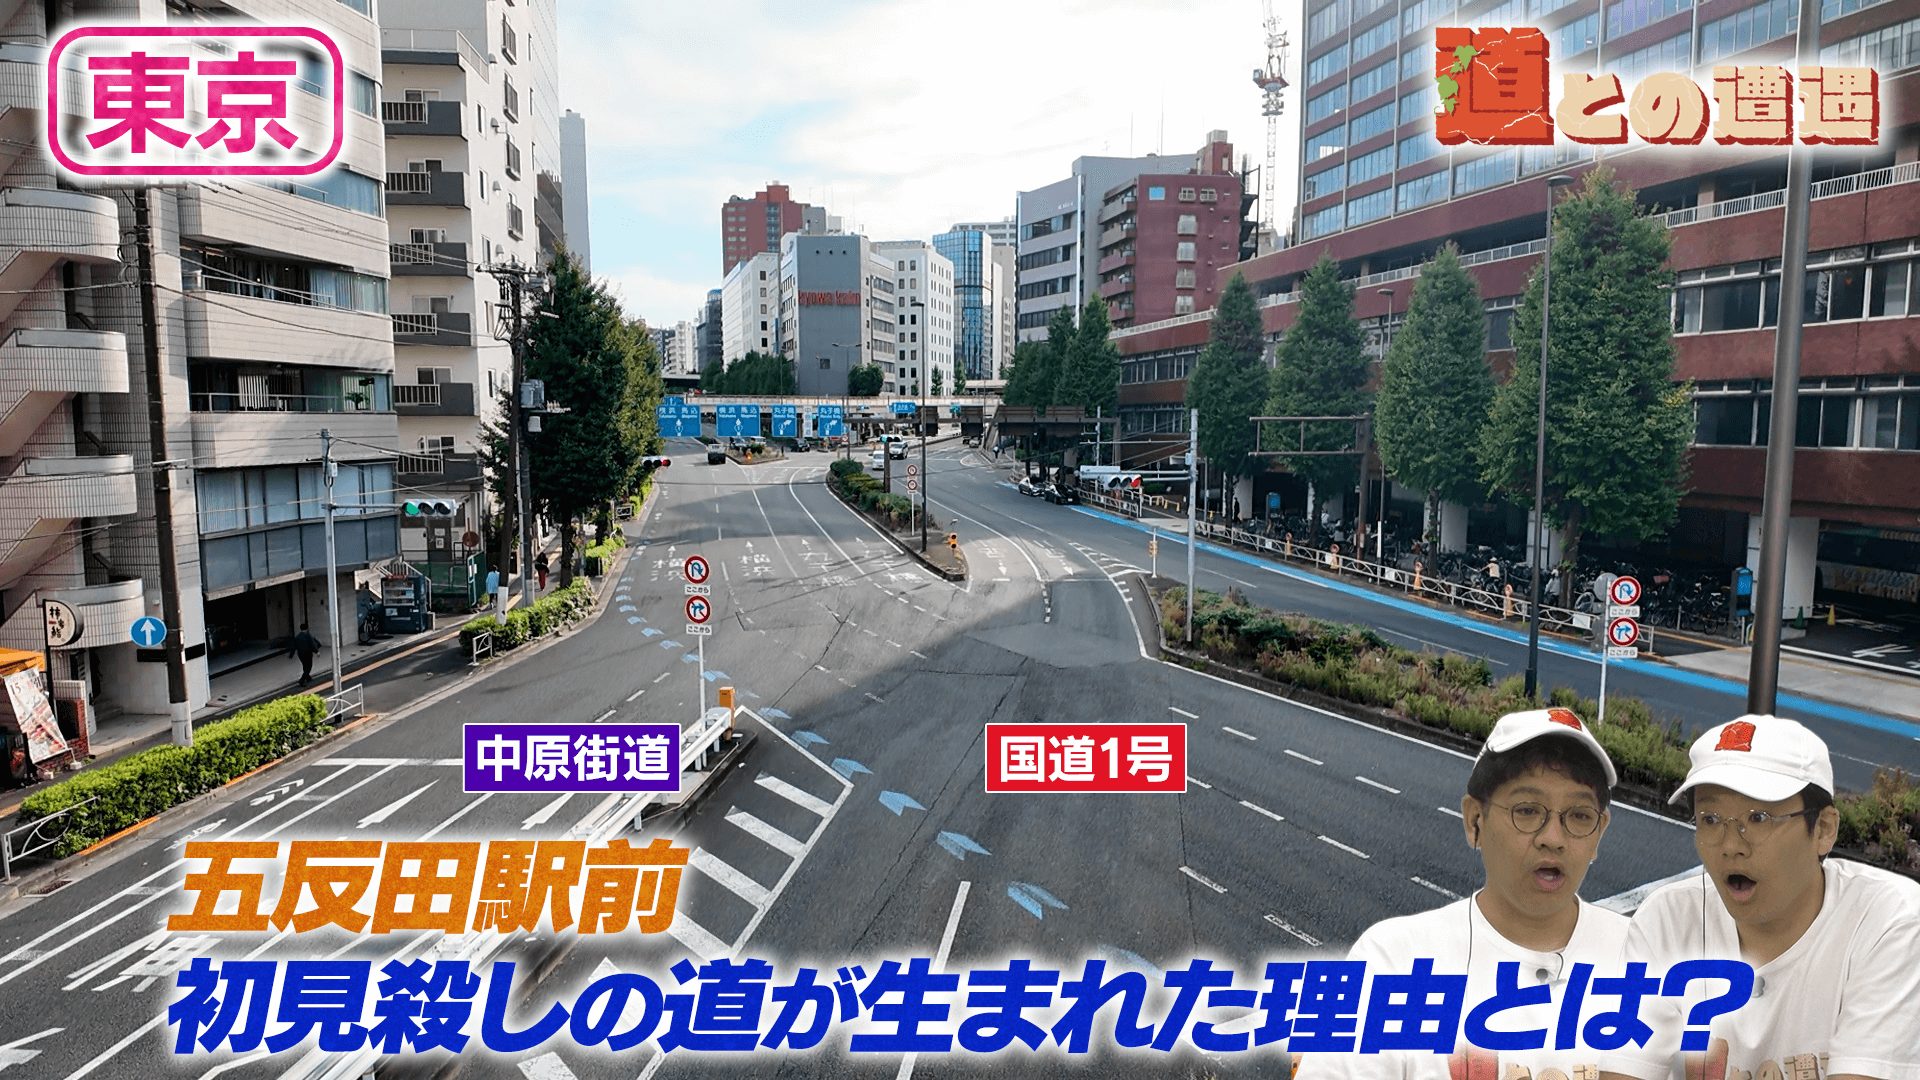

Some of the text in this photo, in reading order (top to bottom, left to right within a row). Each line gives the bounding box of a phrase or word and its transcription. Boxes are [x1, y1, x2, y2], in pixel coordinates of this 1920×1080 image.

[686, 586, 709, 594] ここから
[1611, 608, 1638, 616] ここから
[688, 626, 711, 634] ここから
